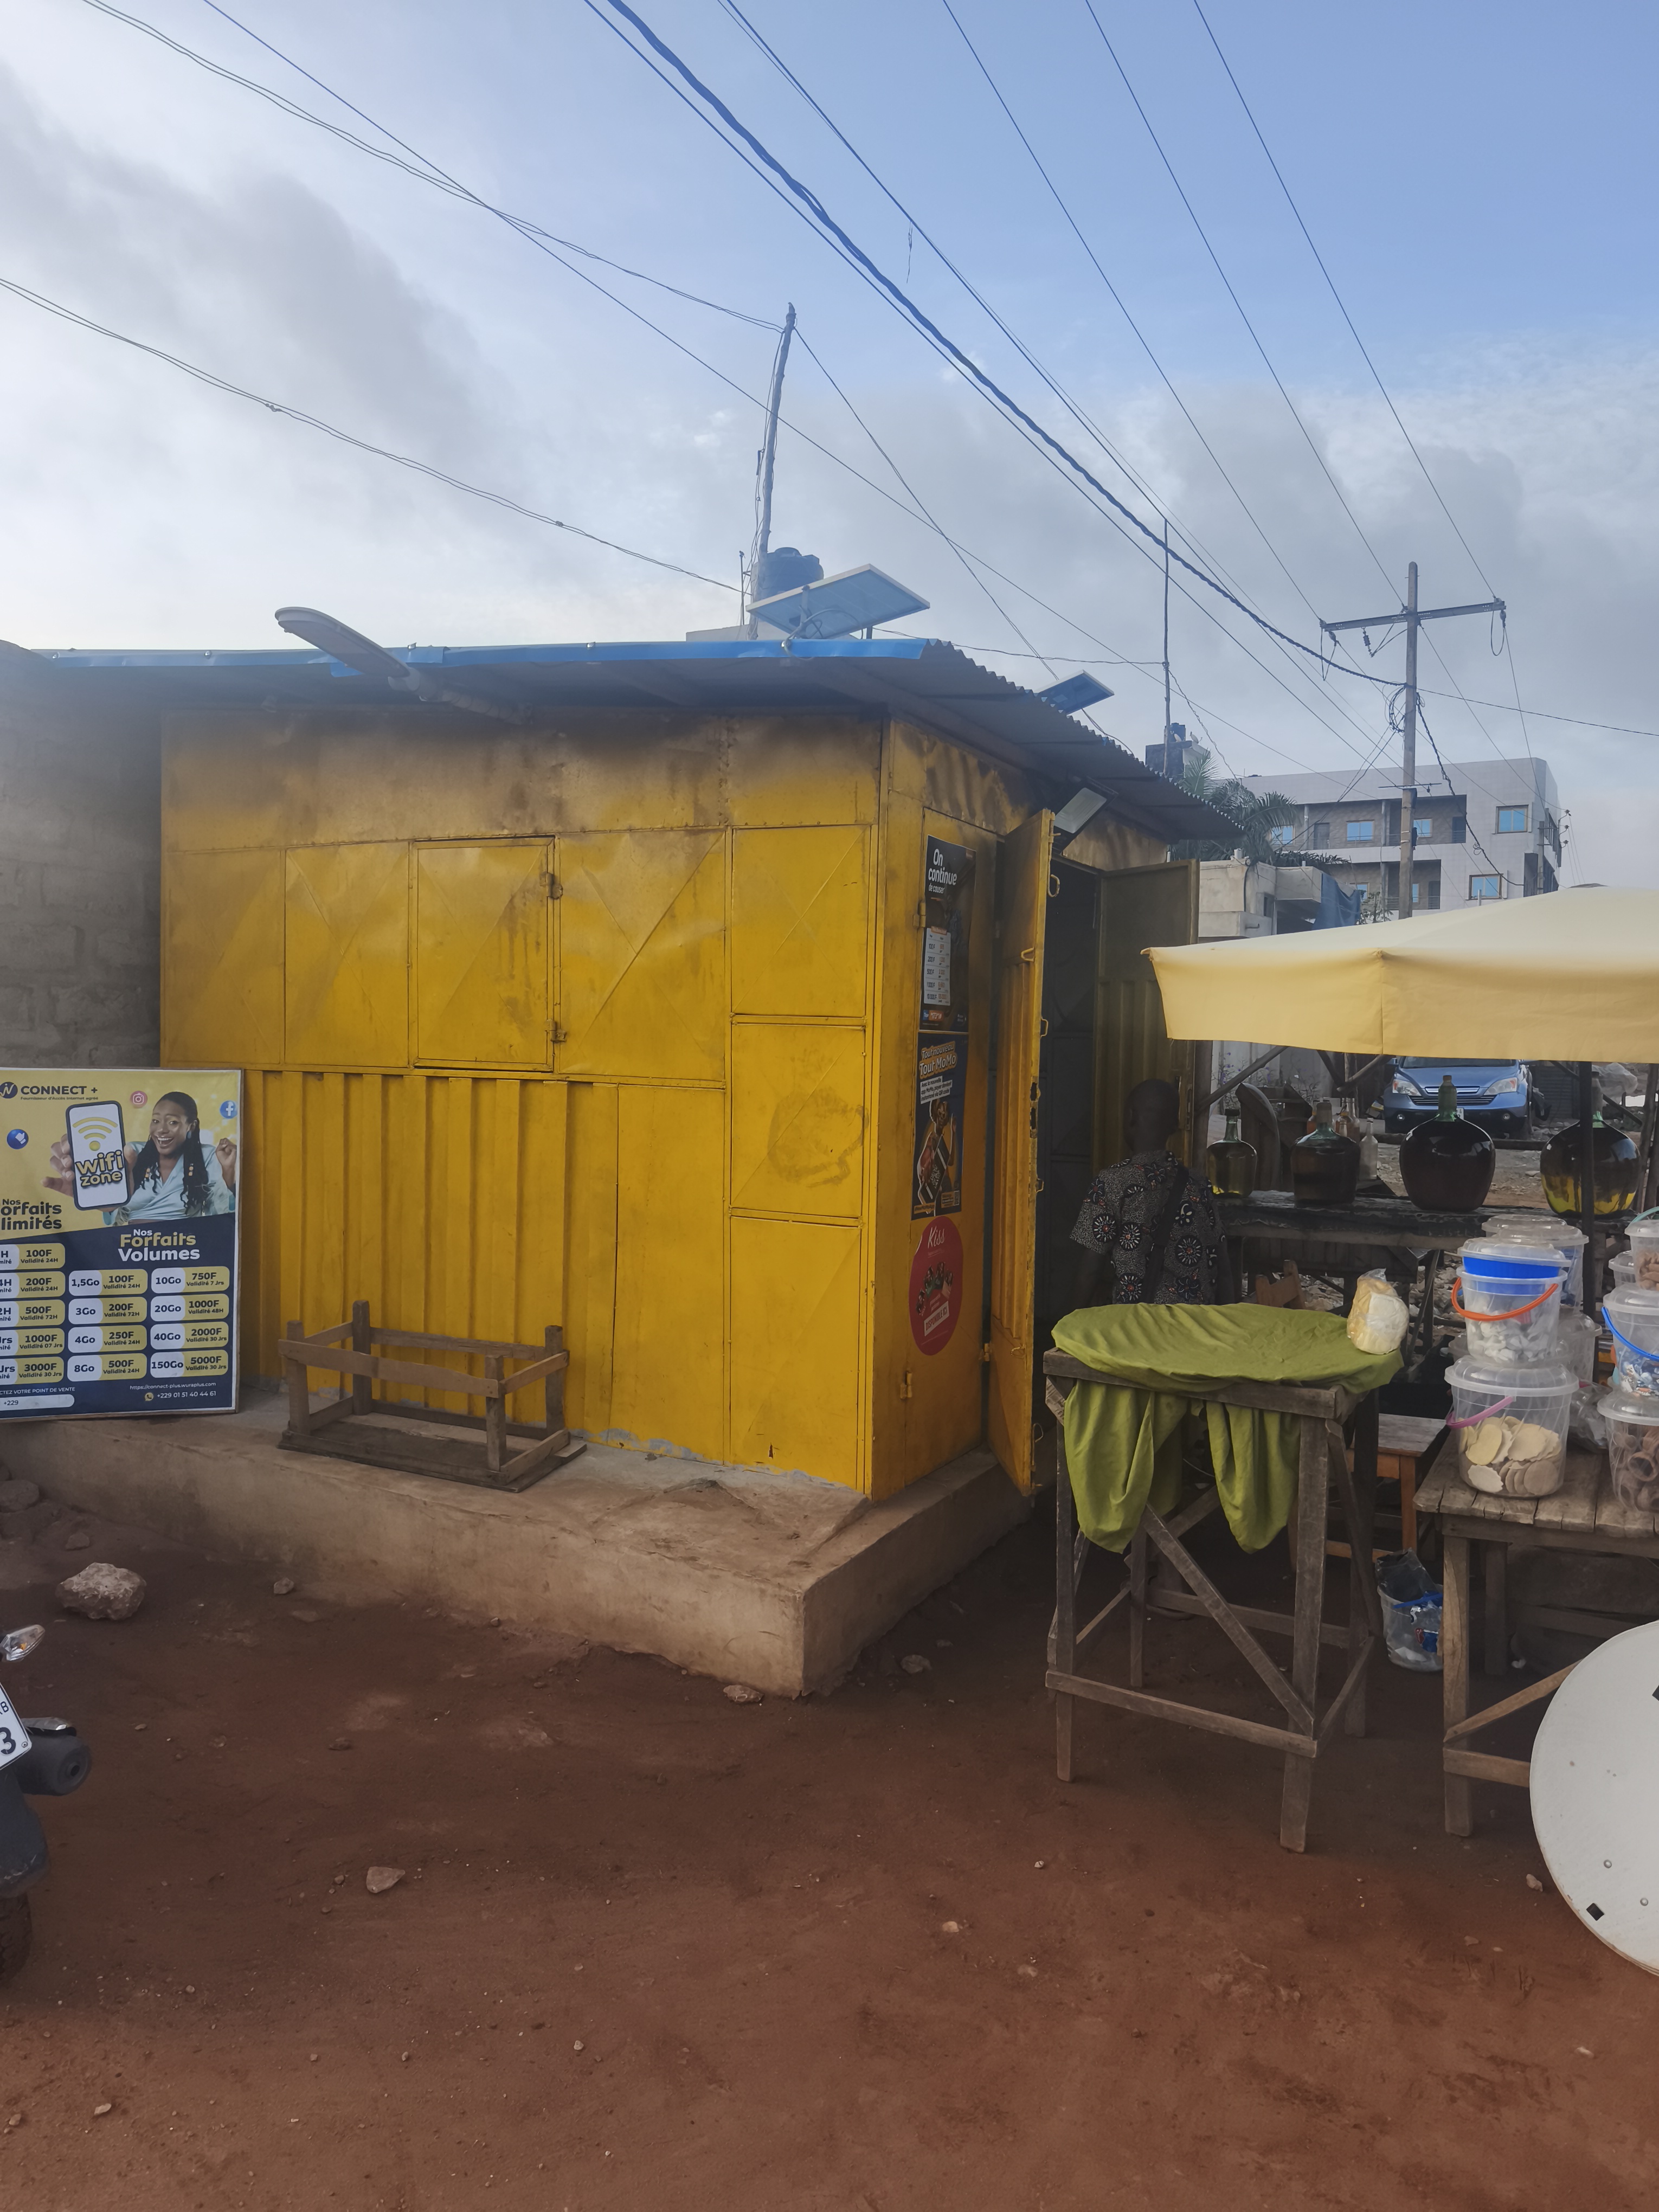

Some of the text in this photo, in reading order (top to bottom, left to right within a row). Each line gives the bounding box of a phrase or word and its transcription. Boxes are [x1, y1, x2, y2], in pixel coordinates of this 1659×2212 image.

[933, 848, 943, 866] On
[928, 866, 957, 885] continue
[928, 883, 933, 892] de
[922, 1044, 954, 1059] Tout nouveau
[919, 1054, 956, 1075] Tout MoMo
[21, 1085, 87, 1095] CONNECT
[75, 1149, 124, 1175] wifi
[80, 1171, 123, 1187] zone
[120, 1232, 196, 1247] Forfaits
[118, 1248, 200, 1262] Volumes
[72, 1278, 100, 1287] 1,5Go
[108, 1275, 134, 1283] 100F
[108, 1303, 133, 1311] 200F
[155, 1304, 181, 1313] 20Go
[189, 1300, 220, 1308] 1000F
[25, 1306, 52, 1314] 500F
[76, 1307, 96, 1315] 3Go
[109, 1331, 134, 1339] 250F
[191, 1328, 222, 1336] 2000F
[25, 1334, 57, 1343] 1000F
[154, 1333, 181, 1341] 40Go
[108, 1359, 134, 1368] 500F
[151, 1361, 184, 1369] 150Go
[190, 1356, 222, 1365] 5000F
[24, 1363, 57, 1372] 3000F
[130, 1382, 216, 1390] https://connect-plus.wuraplus.com
